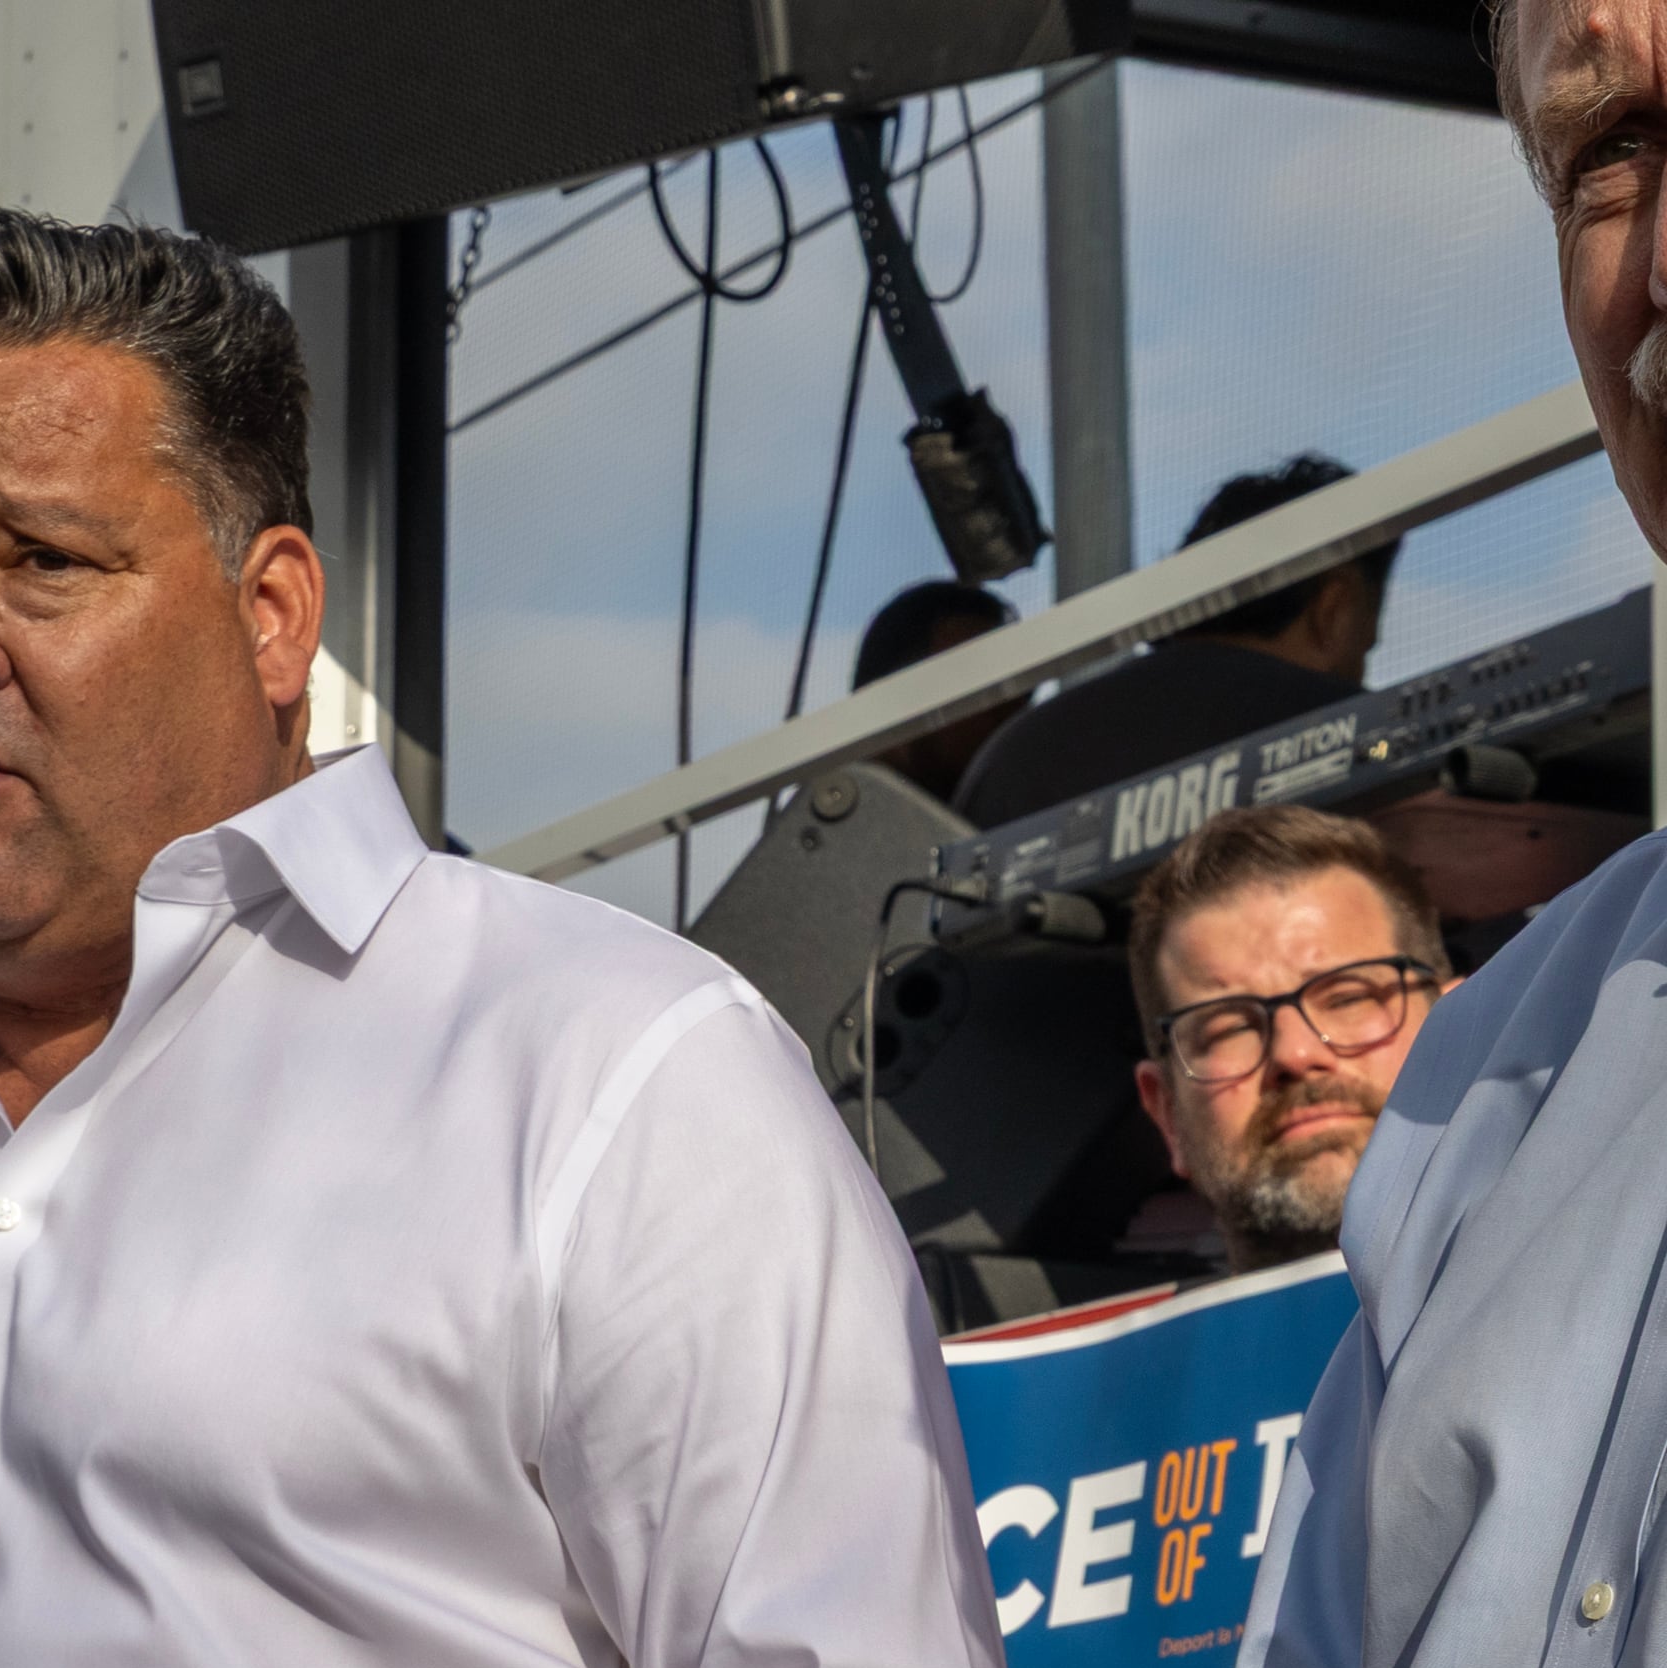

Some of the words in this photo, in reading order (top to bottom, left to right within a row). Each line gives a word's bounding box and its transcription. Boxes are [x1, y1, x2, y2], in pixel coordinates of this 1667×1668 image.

[1109, 750, 1240, 863] KORG
[1258, 713, 1359, 773] TRITON
[1153, 1437, 1238, 1528] OUT
[975, 1459, 1147, 1638] CE
[1155, 1522, 1213, 1607] OF
